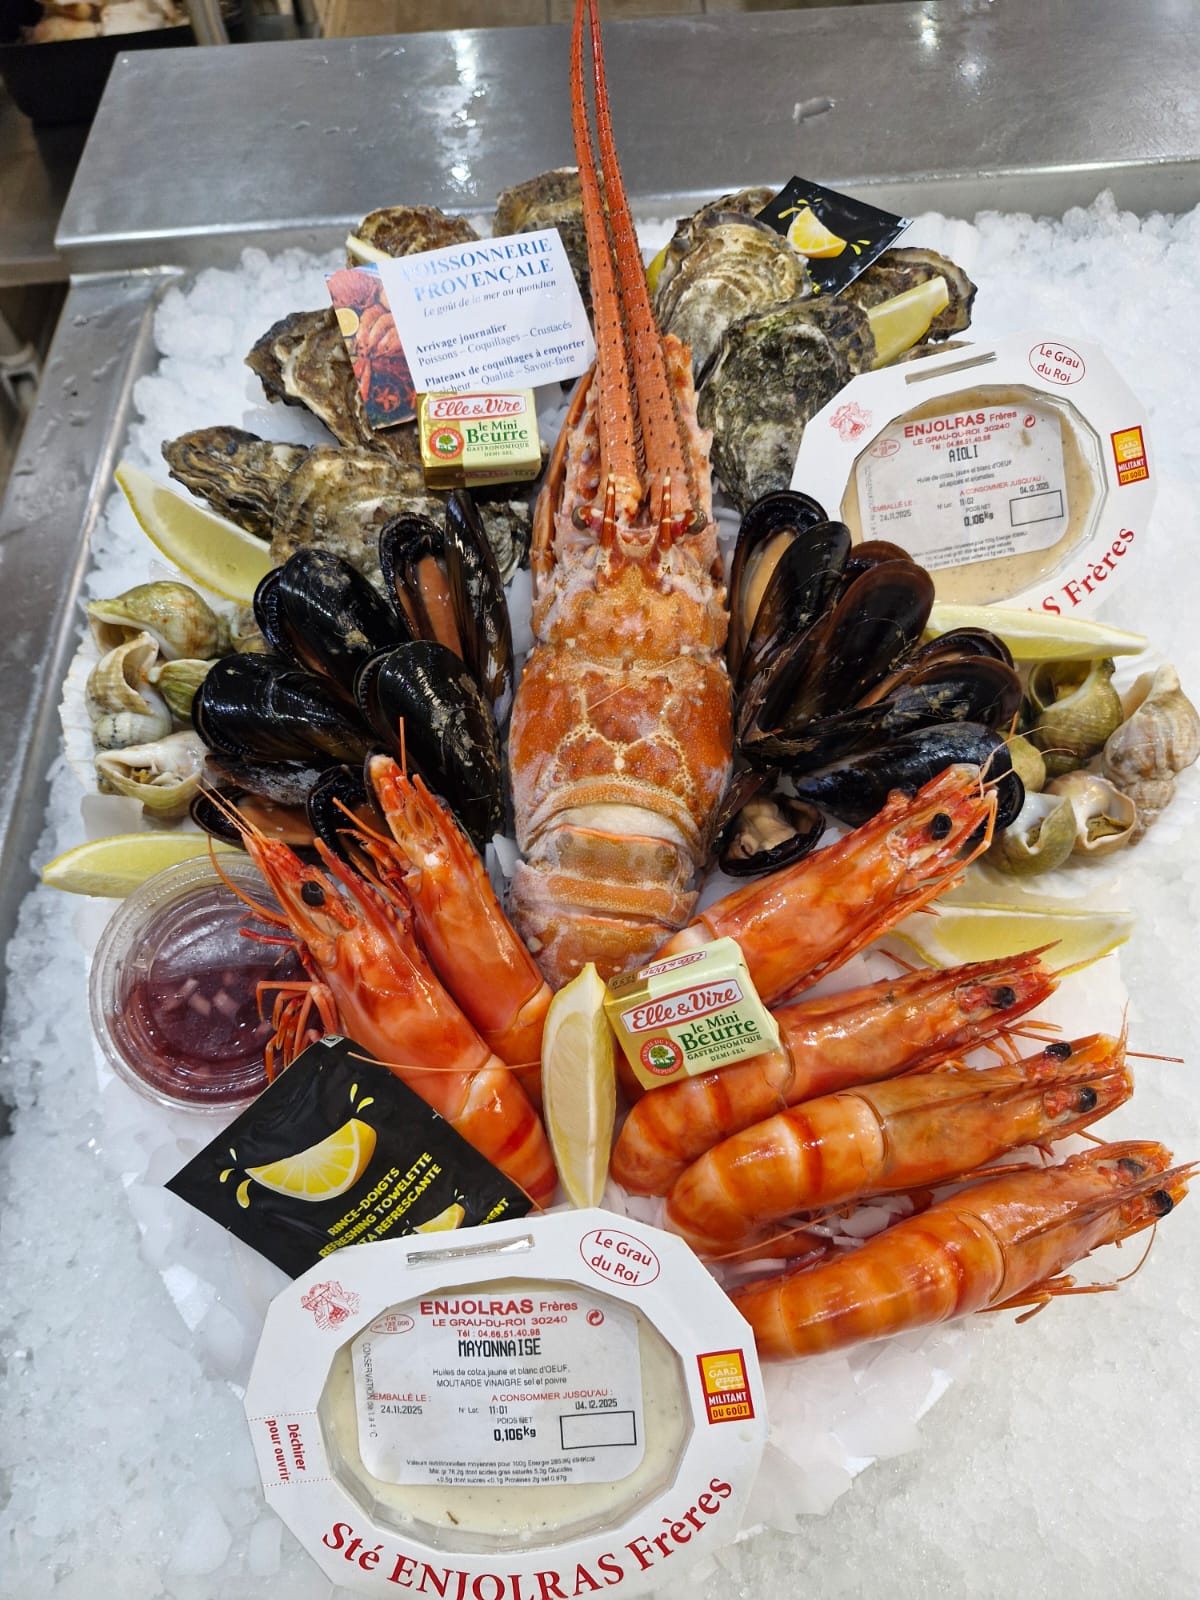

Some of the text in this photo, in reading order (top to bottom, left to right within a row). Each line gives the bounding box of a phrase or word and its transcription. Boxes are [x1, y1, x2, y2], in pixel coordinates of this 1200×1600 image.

[402, 238, 552, 281] POISSONNERIE
[414, 258, 554, 302] PROVENÇALE
[423, 307, 434, 317] Le
[437, 303, 457, 316] goût
[458, 299, 470, 308] de
[484, 291, 500, 301] mer
[503, 288, 514, 296] au
[516, 280, 556, 296] quotidien
[416, 324, 507, 355] Arrivage journalier
[418, 320, 572, 367] Poissons Coquillages Crustacés
[425, 340, 586, 387] Plateaux de coquillages à emporter
[1039, 344, 1080, 369] Le Grau
[481, 370, 514, 385] Qualité
[524, 355, 575, 374] Savoir-faire
[1037, 362, 1072, 383] du Roi
[434, 399, 522, 418] Elle & Vire
[478, 420, 517, 431] le Mini
[904, 411, 1017, 438] ENJOLRAS Frères
[466, 429, 528, 444] Beurre
[913, 438, 923, 446] LE
[925, 429, 981, 443] GRAU-DU-ROI
[948, 445, 979, 463] AIOLI
[1118, 458, 1145, 472] MILITANT
[966, 481, 1009, 495] CONSOMMER
[1060, 528, 1135, 607] Frères
[632, 988, 737, 1030] Elle & Vire
[690, 1011, 739, 1035] le Mini
[678, 1020, 757, 1051] Beurre
[687, 1034, 763, 1060] GASTRONOMIQUE
[710, 1047, 746, 1062] DEMI-SEL
[319, 1152, 433, 1258] REFRESHING TOWELETTE
[327, 1167, 400, 1236] RINCE-DOIGTS
[375, 1163, 442, 1236] REFRESCANTE
[595, 1232, 652, 1266] Le Grau
[591, 1254, 640, 1284] du Roi
[420, 1299, 578, 1316] ENJOLRAS Frères
[432, 1315, 568, 1328] LE GRAU-DU-ROI 30240
[457, 1329, 469, 1337] Tél
[458, 1338, 541, 1357] MAYONNAISE
[433, 1368, 455, 1376] Huiles
[456, 1368, 465, 1376] de
[518, 1367, 538, 1375] blanc
[708, 1367, 738, 1378] GARD
[485, 1379, 521, 1387] VINAIGRE
[523, 1378, 534, 1386] sel
[544, 1377, 567, 1388] poivre
[372, 1391, 413, 1401] EMBALLÉ
[500, 1391, 561, 1402] CONSOMMER
[562, 1390, 608, 1401] JUSQU'AU
[575, 1399, 618, 1411] 04.12.2025
[708, 1392, 747, 1406] MILITANT
[381, 1405, 423, 1415] 24.11.2025
[489, 1406, 508, 1415] 11:01
[518, 1416, 533, 1424] NET
[713, 1404, 747, 1418] DU GOÛT
[265, 1419, 291, 1481] pour ouvrir
[287, 1423, 306, 1471] Déchirer
[322, 1478, 732, 1600] Sté ENJOLRAS Frères
